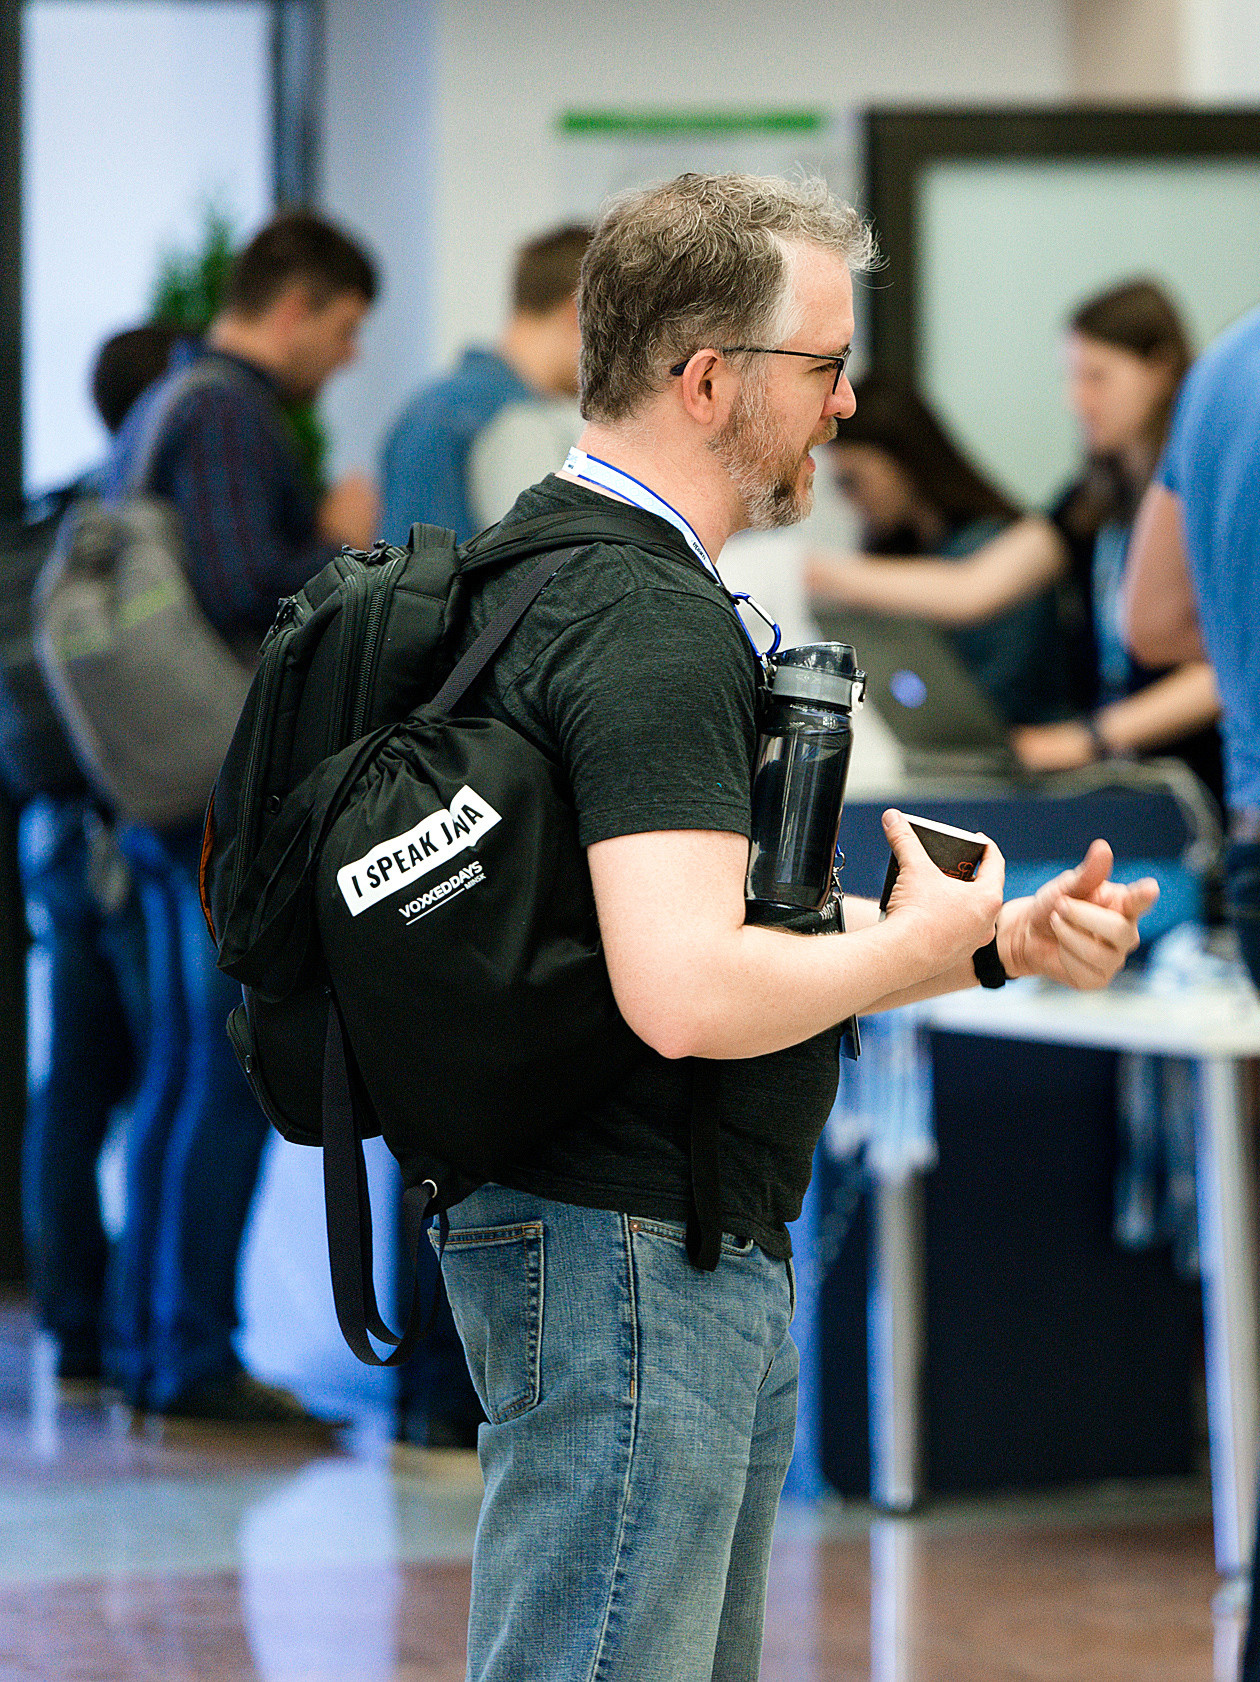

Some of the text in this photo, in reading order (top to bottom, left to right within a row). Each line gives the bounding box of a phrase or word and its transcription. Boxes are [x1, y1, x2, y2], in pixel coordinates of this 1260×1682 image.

[351, 875, 363, 898] I
[366, 831, 439, 889] SPEAK
[463, 873, 487, 890] MINSK
